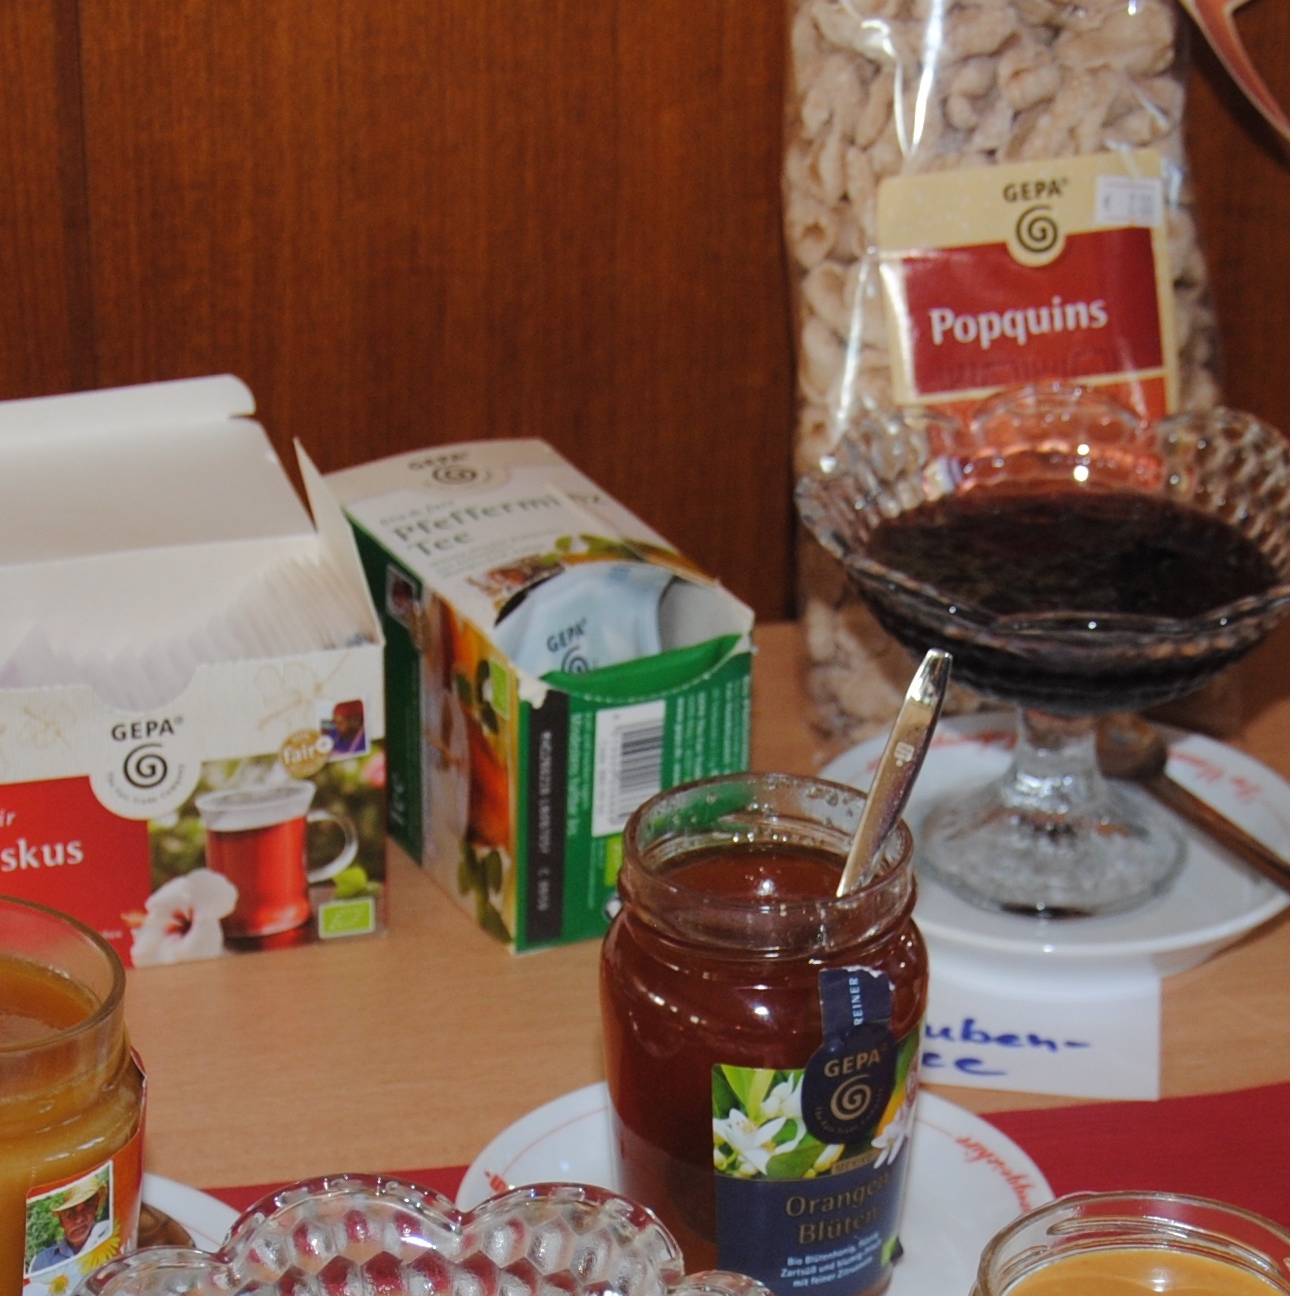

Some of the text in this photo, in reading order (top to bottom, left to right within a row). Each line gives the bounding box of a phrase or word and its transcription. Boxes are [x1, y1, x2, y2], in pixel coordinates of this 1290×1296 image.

[1003, 179, 1061, 201] GEPA
[928, 296, 1108, 350] Popquins
[546, 620, 584, 654] GEPA
[111, 718, 176, 742] GEPA
[281, 741, 317, 764] fair
[848, 977, 864, 1027] REINER
[925, 1017, 1095, 1054] uben-
[824, 1050, 881, 1078] GEPA
